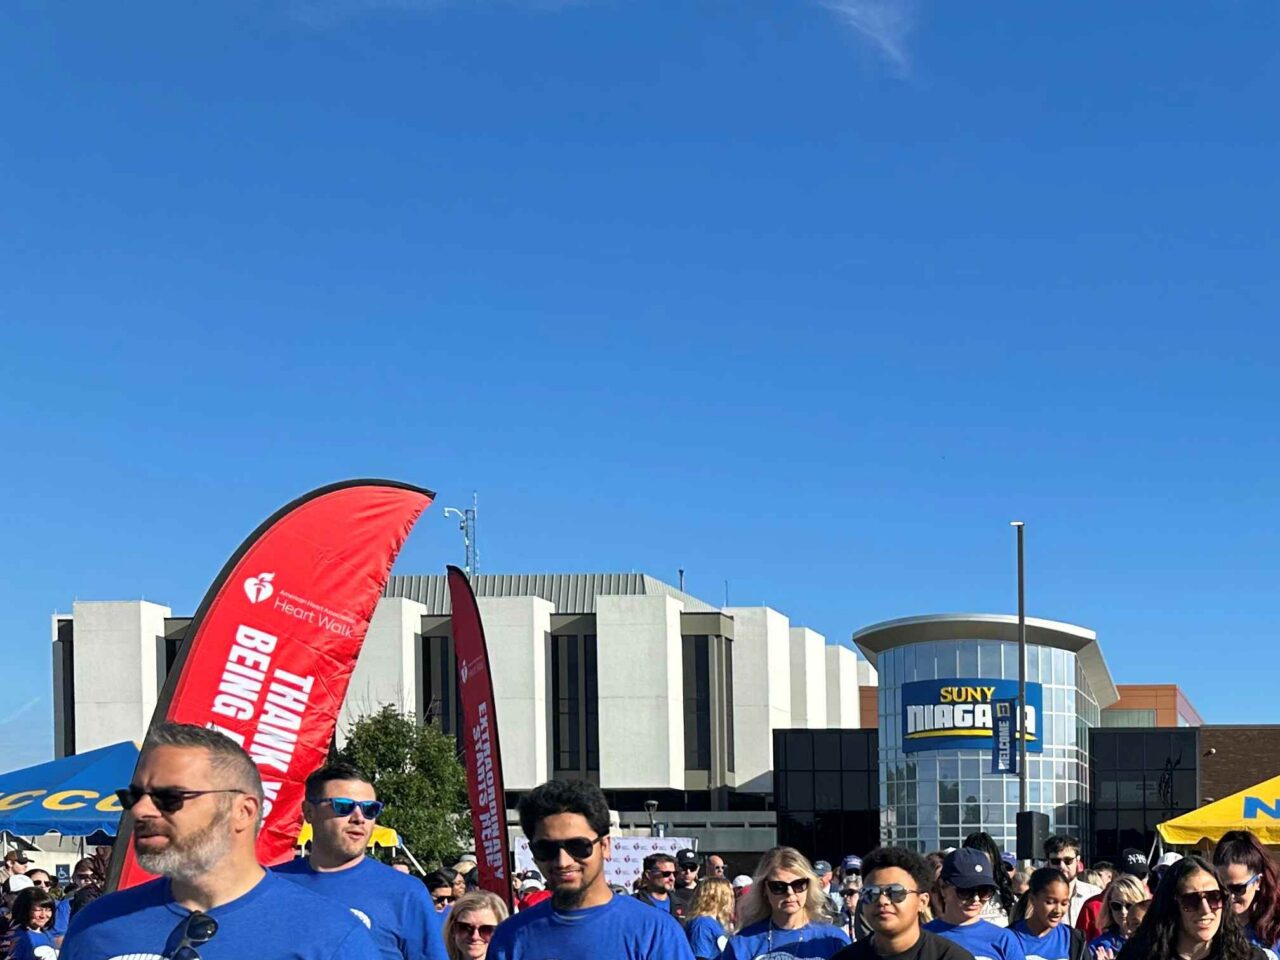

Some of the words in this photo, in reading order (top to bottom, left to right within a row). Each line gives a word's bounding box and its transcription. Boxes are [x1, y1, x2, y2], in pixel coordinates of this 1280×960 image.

[273, 597, 315, 623] Heart
[318, 614, 353, 638] Walk
[211, 624, 278, 722] BEING
[940, 686, 996, 702] SUNY
[249, 668, 315, 773] THANK
[906, 703, 1036, 733] NIAGAA
[998, 720, 1011, 770] WELCOME
[472, 724, 489, 807] STARTS
[478, 701, 505, 880] EXTRAORDINARY
[479, 811, 494, 867] HERE
